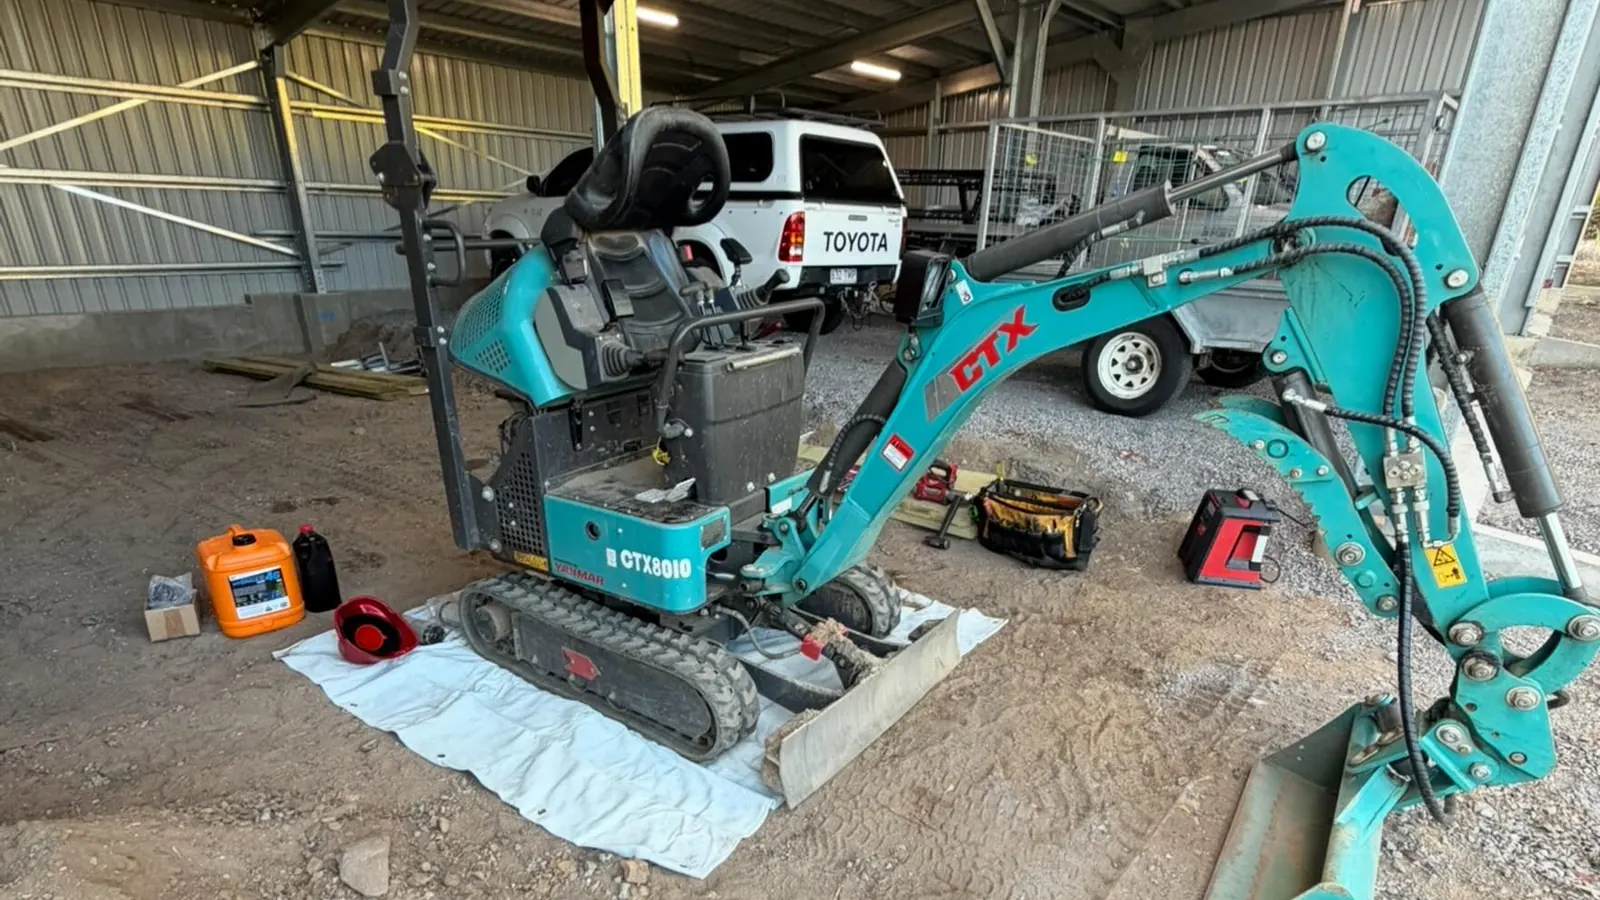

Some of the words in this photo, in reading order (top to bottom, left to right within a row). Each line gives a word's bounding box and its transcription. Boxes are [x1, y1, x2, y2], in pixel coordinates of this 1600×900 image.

[823, 231, 888, 252] TOYOTA
[948, 304, 1040, 392] CTX
[555, 562, 604, 585] YANMAR
[620, 549, 691, 579] CTX8010
